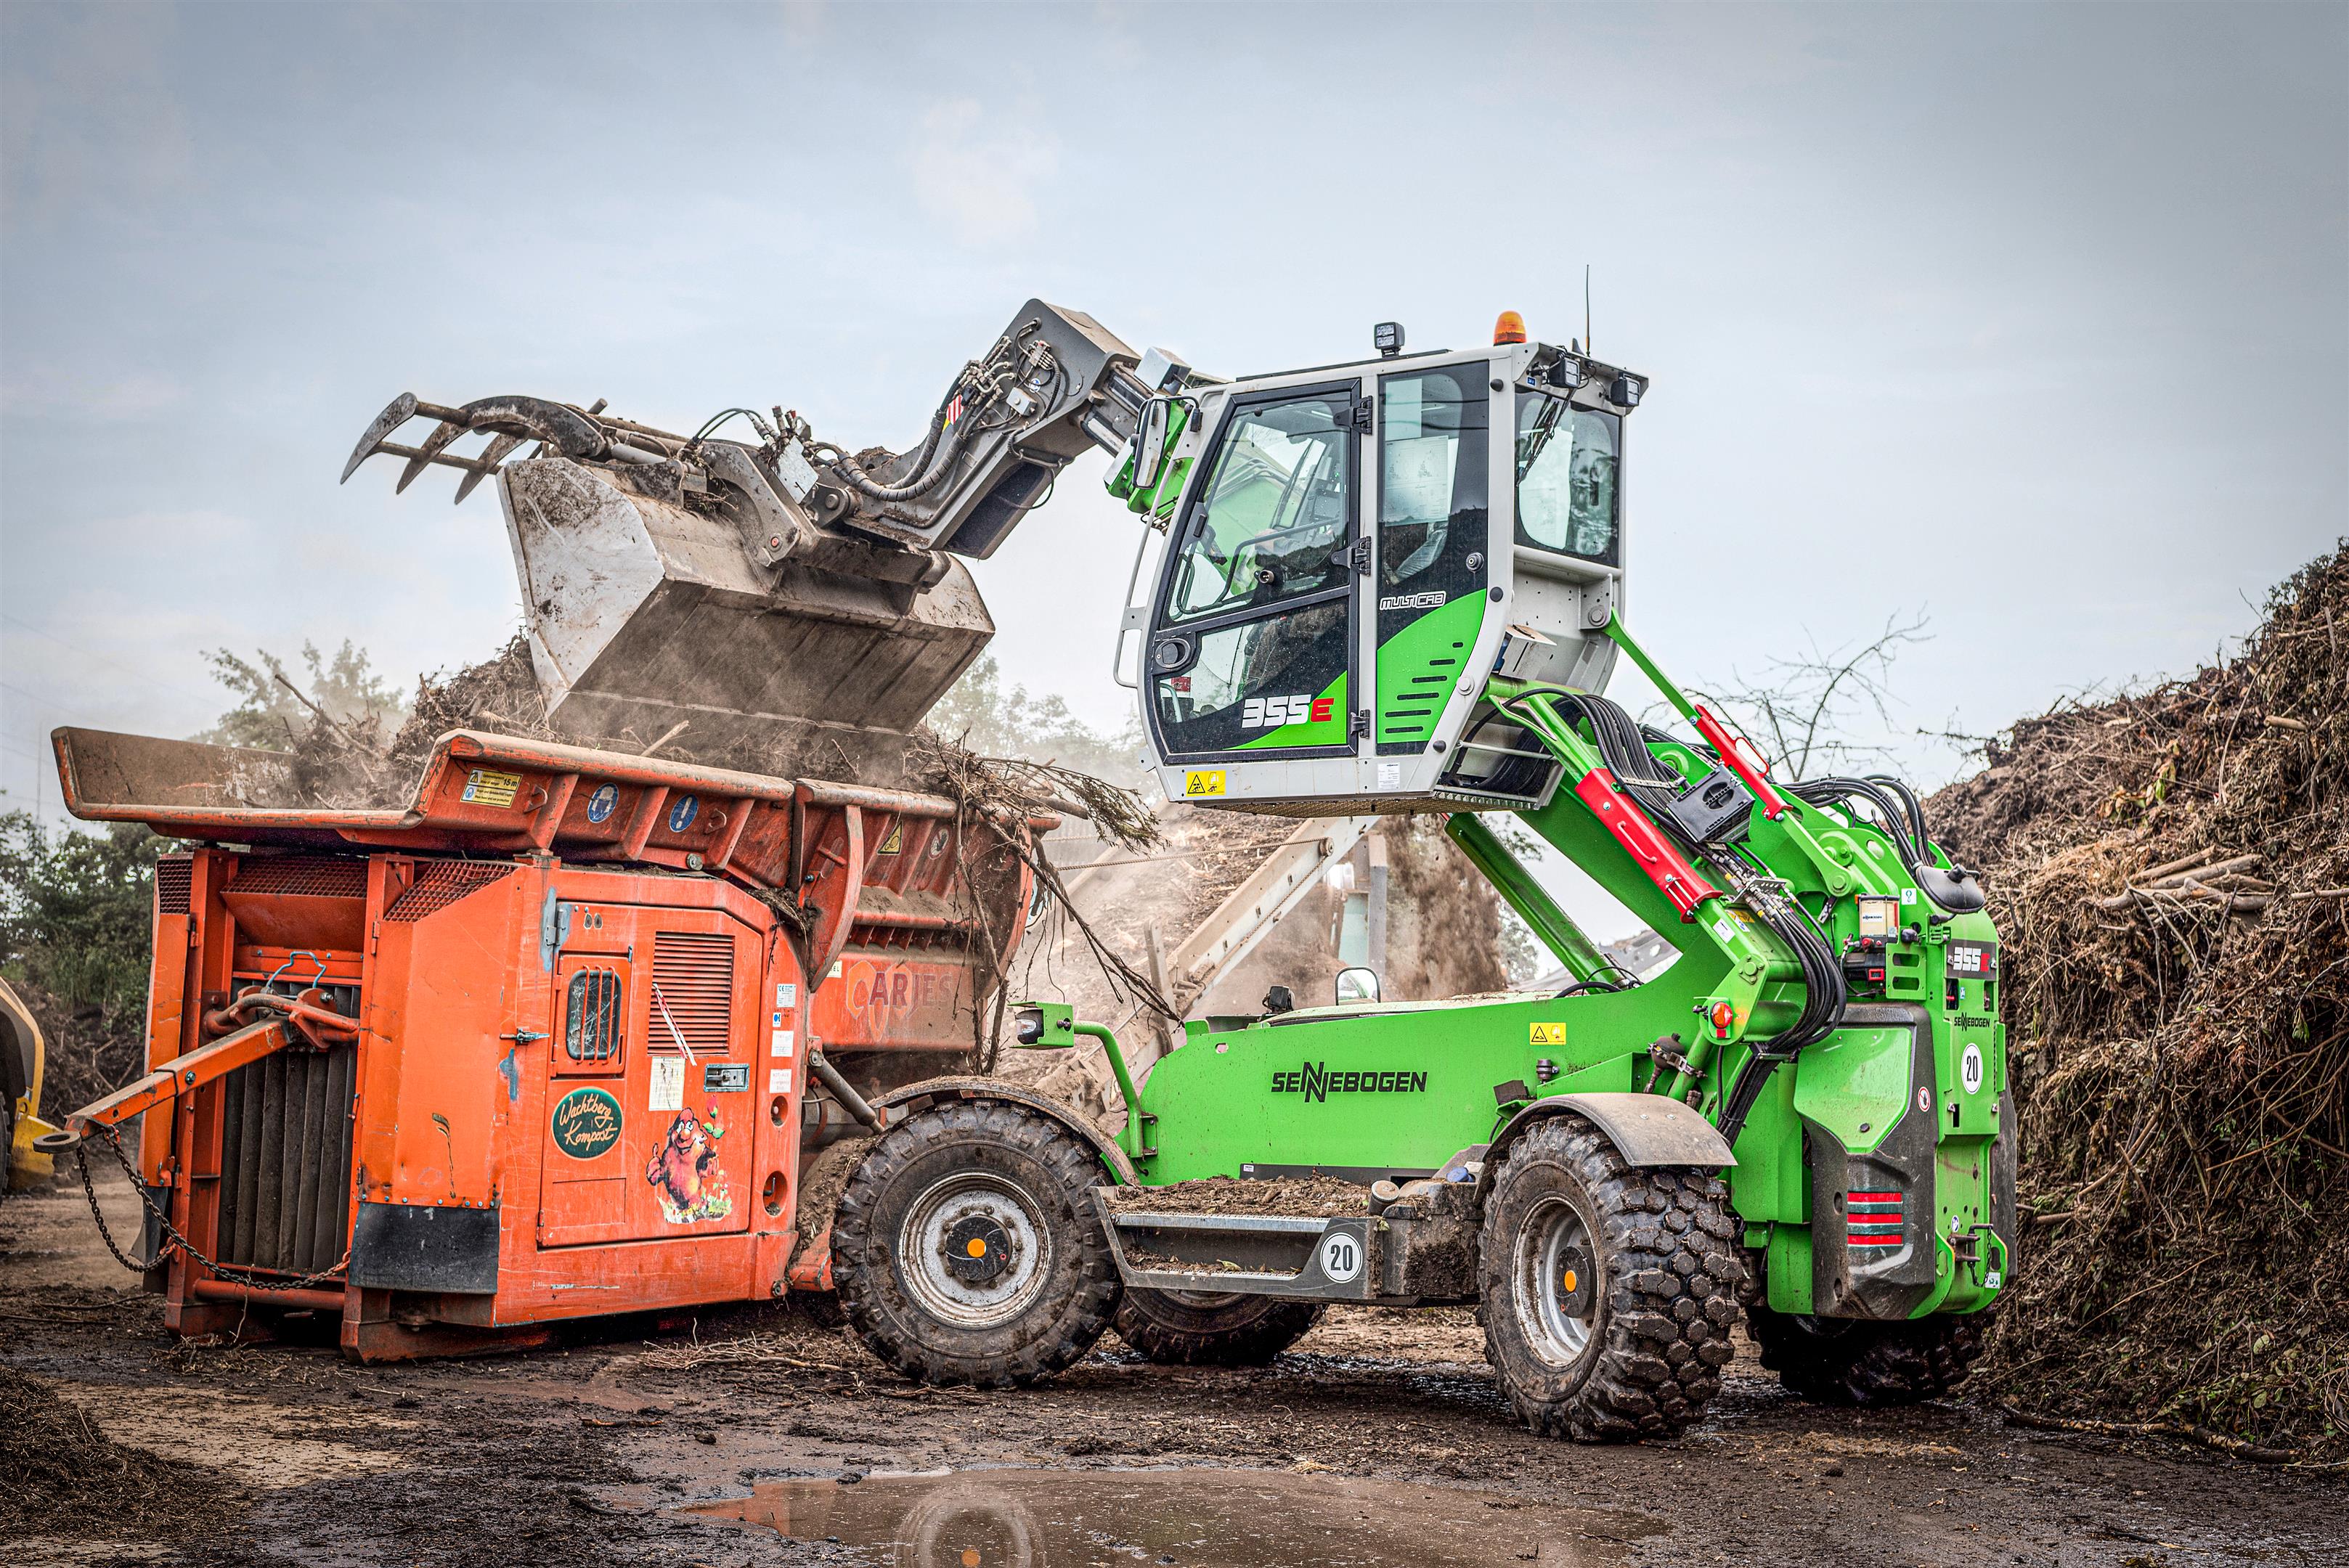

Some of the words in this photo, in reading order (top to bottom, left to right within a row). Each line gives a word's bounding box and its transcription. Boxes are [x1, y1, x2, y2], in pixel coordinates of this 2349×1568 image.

[1380, 591, 1446, 611] MULTICAB
[1242, 694, 1335, 728] 355E
[1953, 947, 1990, 972] 355E
[1954, 1012, 1990, 1032] SENNEBOGEN
[1271, 1061, 1428, 1103] SENNEBOGEN
[1966, 1055, 1978, 1082] 20
[560, 1093, 614, 1129] Wachtberg
[564, 1119, 618, 1151] Kompost
[1330, 1244, 1353, 1272] 20
